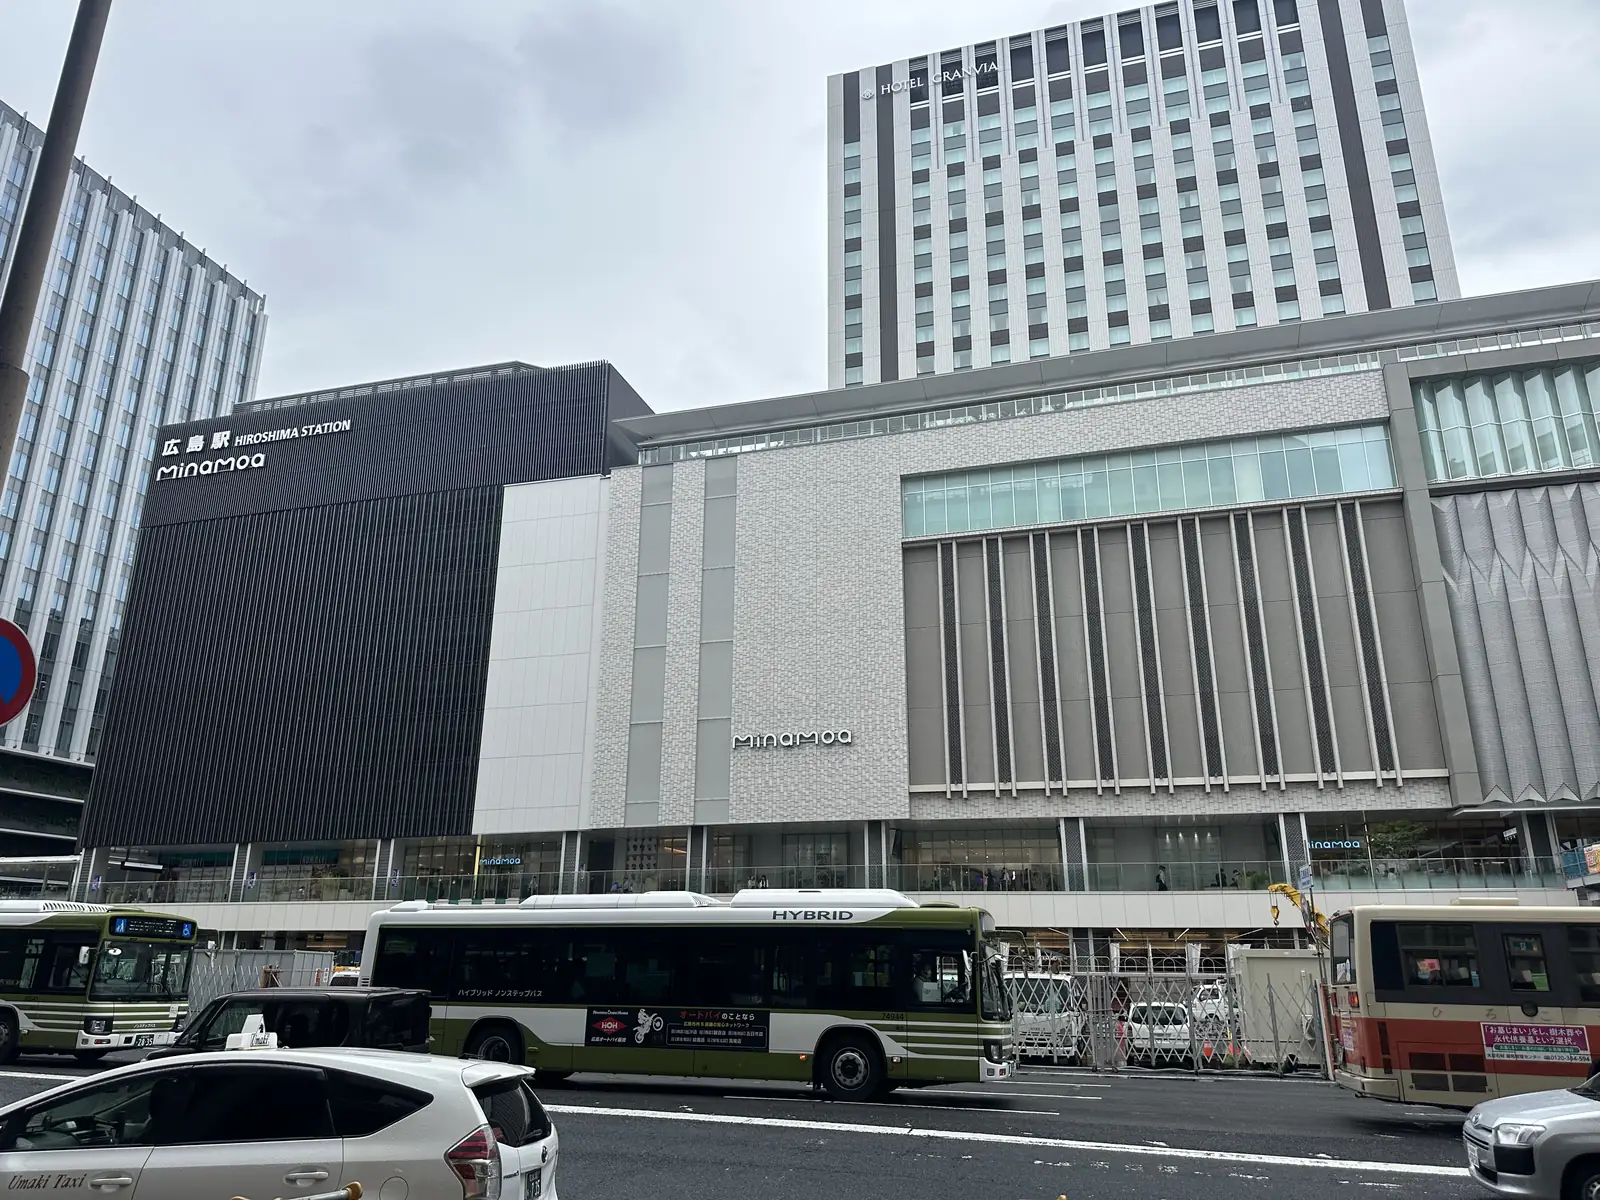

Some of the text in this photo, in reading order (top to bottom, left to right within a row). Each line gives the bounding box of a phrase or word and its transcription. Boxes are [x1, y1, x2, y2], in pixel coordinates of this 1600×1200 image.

[881, 61, 998, 95] HOTEL GRANVIA
[161, 419, 351, 456] 広島駅 HIROSHIMA STATION
[772, 910, 854, 921] HYBRID
[457, 988, 543, 997] ハイブリッド ノンステップバス
[679, 1010, 755, 1021] オートバイのことなら
[601, 1021, 618, 1030] HOH
[8, 1173, 88, 1190] Umaki Taxi
